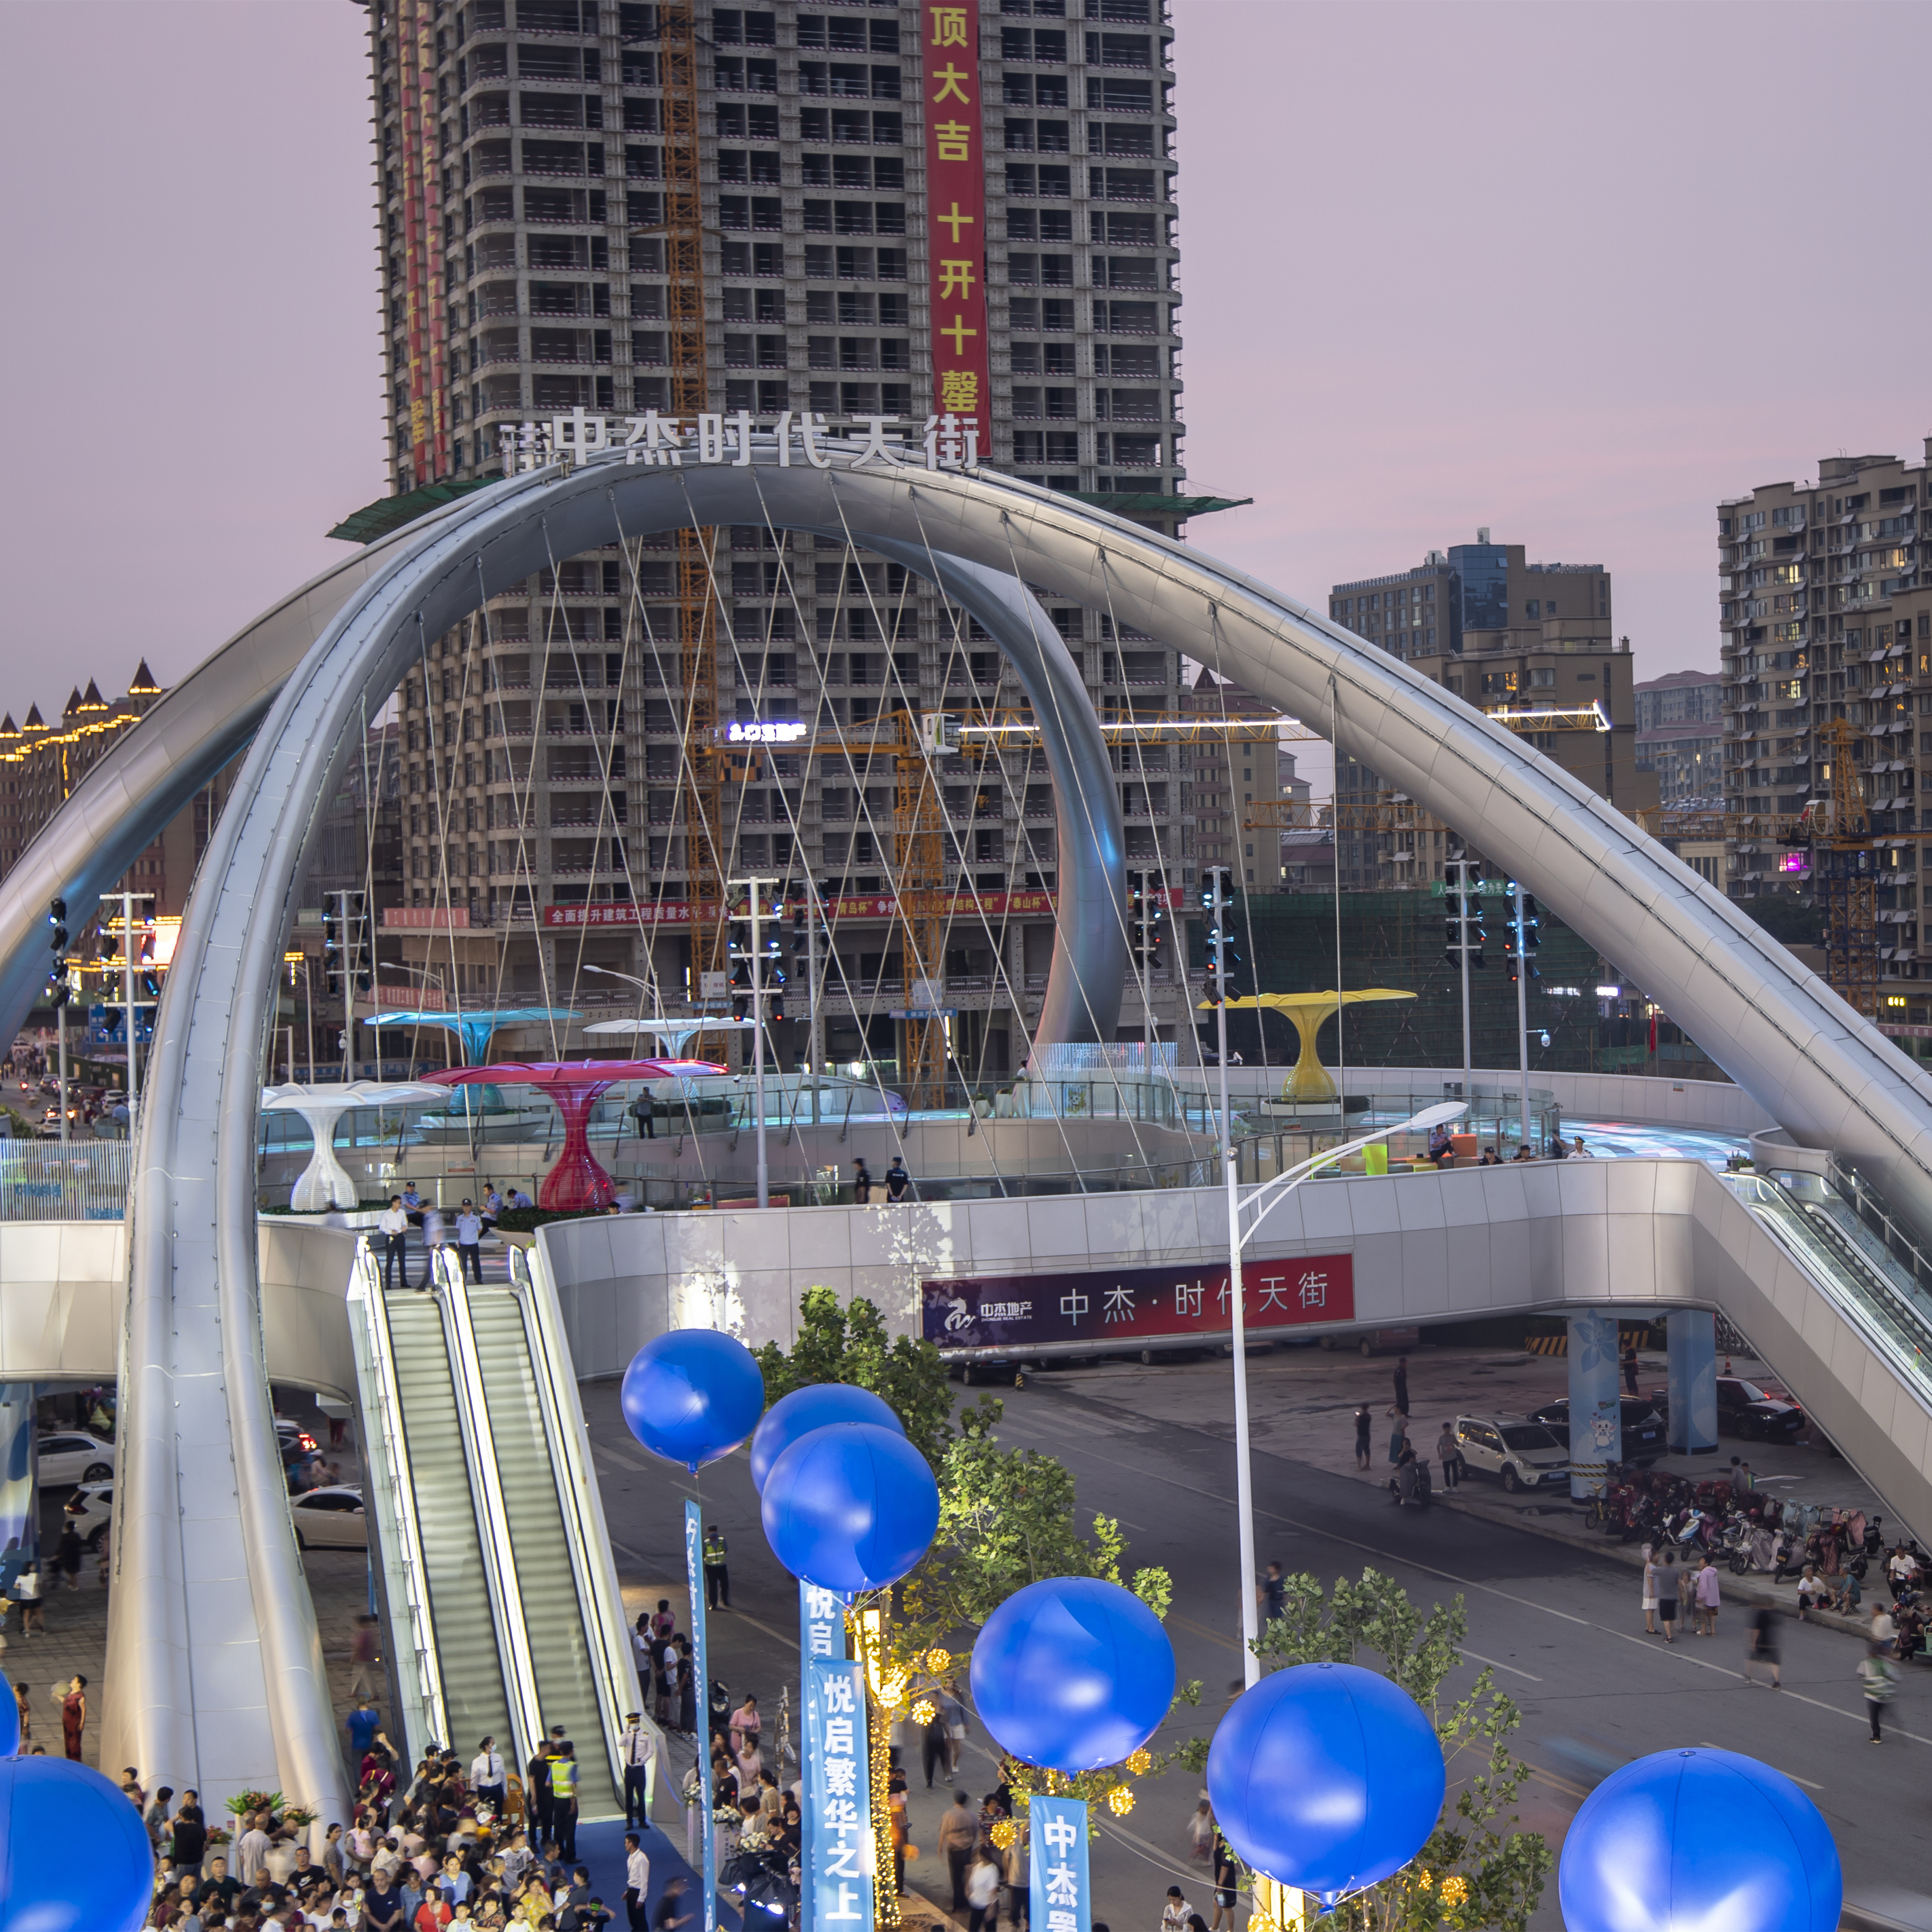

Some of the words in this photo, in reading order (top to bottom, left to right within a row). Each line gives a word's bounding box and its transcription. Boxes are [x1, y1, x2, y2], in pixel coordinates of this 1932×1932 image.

[929, 6, 970, 162] 顶大吉
[937, 202, 979, 413] 十开十罄
[552, 406, 980, 469] 中杰时代天街
[981, 1301, 1032, 1317] 中杰地产
[1059, 1271, 1329, 1326] 中杰·时代天街
[824, 1674, 862, 1920] 悦启繁华之上
